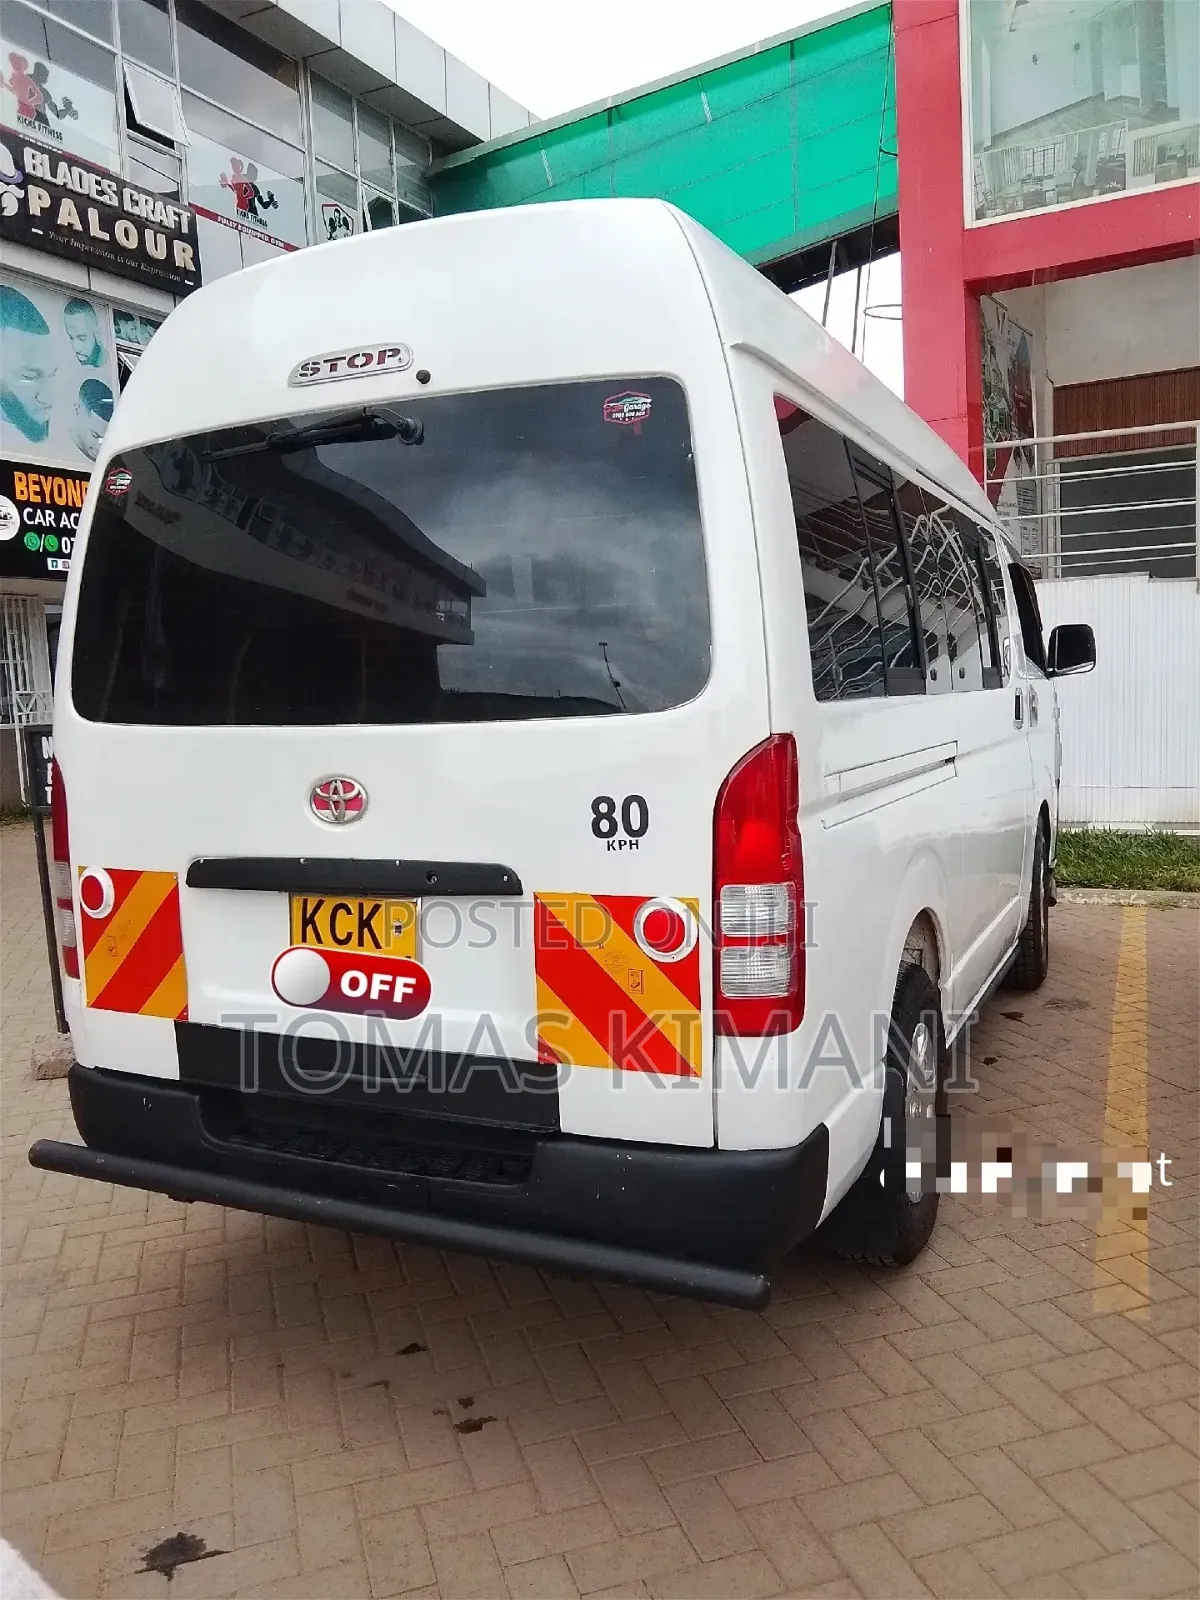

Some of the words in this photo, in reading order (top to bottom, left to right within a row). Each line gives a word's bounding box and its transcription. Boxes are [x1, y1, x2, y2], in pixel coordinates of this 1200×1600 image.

[17, 114, 36, 130] KICKS
[38, 122, 63, 141] FITNESS
[23, 146, 119, 207] BLADES
[122, 187, 191, 234] CRAFT
[27, 184, 197, 272] PALOUR
[49, 231, 68, 245] Your
[217, 216, 238, 229] FULLY
[238, 224, 269, 242] EQUIPPED
[270, 238, 285, 249] GYM
[299, 347, 401, 378] STOP
[23, 507, 57, 528] CAR
[591, 794, 649, 839] 80
[607, 839, 639, 851] KPH
[301, 898, 382, 949] KCK
